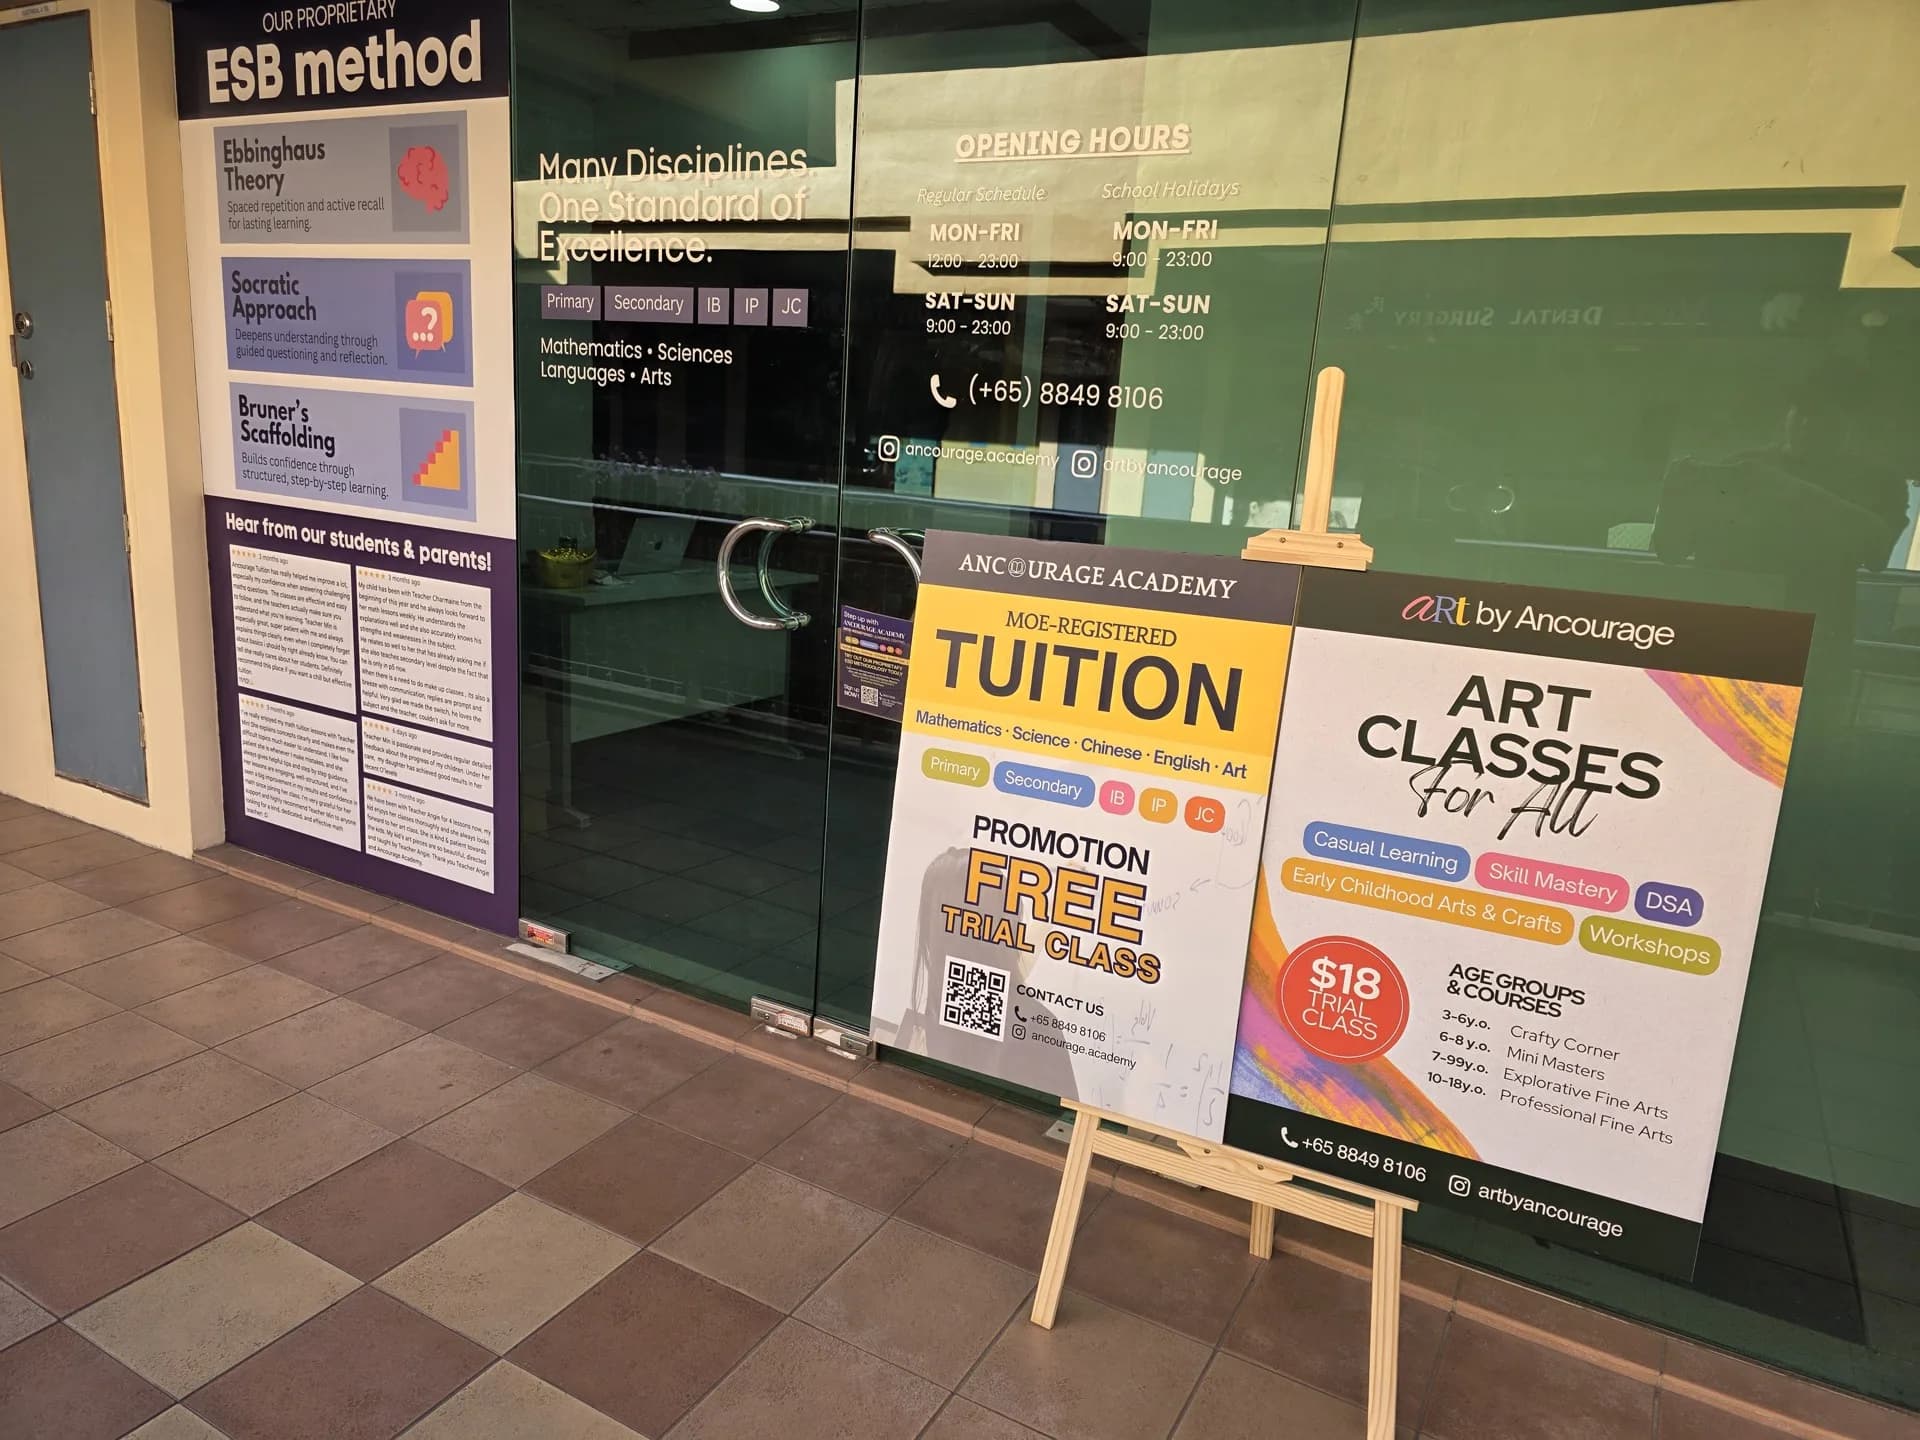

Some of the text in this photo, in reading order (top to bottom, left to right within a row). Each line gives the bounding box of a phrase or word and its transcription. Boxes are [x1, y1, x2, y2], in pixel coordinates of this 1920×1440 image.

[263, 0, 398, 32] OUR PROPRIETARY
[207, 18, 482, 104] ESB method
[223, 136, 326, 169] Ebbinghaus
[955, 123, 1191, 159] OPENING HOURS
[223, 166, 285, 196] Theory
[539, 142, 817, 190] Many Disciplines.
[227, 197, 385, 214] Spaced repetition and active recall
[539, 186, 810, 224] One Standard of
[917, 184, 1048, 206] Regular Schedule
[1102, 180, 1241, 200] School Holidays
[228, 217, 312, 233] for lasting learning.
[930, 223, 1021, 242] MON-FRI
[1113, 220, 1218, 240] MON-FRI
[540, 229, 714, 264] Excellence.
[928, 254, 1018, 269] 12:00 23:00
[1112, 252, 1212, 267] 9:00 23:00
[231, 270, 300, 296] Socratic
[232, 296, 317, 325] Approach
[546, 294, 594, 312] Primary
[614, 294, 684, 316] Secondary
[706, 297, 721, 313] IB
[744, 298, 760, 314] IP
[782, 298, 802, 314] JC
[925, 292, 1016, 311] SAT-SUN
[1106, 294, 1210, 314] SAT-SUN
[234, 328, 378, 349] Deepens understanding through
[926, 320, 1011, 335] 9:00 23:00
[1106, 324, 1204, 340] 9:00 23:00
[236, 345, 388, 366] guided questioning and reflection.
[540, 337, 733, 365] Mathematics Sciences
[540, 360, 672, 387] Languages Arts
[969, 372, 1164, 410] (+65) 8849 8106
[240, 420, 336, 457] Scaffolding
[241, 452, 355, 477] Builds confidence through
[905, 442, 1060, 470] ancourage.academy
[1103, 457, 1242, 482] artbyancourage
[242, 469, 390, 500] structured, step-by-step learning.
[226, 511, 492, 572] Hear from our students & parents!
[1108, 569, 1238, 600] ACADEMY
[1004, 610, 1178, 648] MOE-REGISTERED
[1476, 602, 1511, 633] by
[1515, 604, 1675, 650] Ancourage
[935, 628, 1243, 732] TUITION
[1446, 674, 1592, 732] ART
[916, 709, 1248, 780] Mathematics Science Chinese English Art
[1357, 714, 1664, 800] CLASSES
[930, 756, 982, 782] Primary
[1004, 770, 1082, 800] Secondary
[1110, 789, 1125, 806] IB
[1152, 797, 1167, 812] IP
[1496, 774, 1599, 841] All
[1194, 806, 1215, 824] JC
[972, 814, 1150, 876] PROMOTION
[1314, 830, 1458, 874] Casual Learning
[964, 847, 1148, 946] FREE
[1292, 866, 1562, 934] Early Childhood Arts & Crafts
[1489, 863, 1618, 905] Skill Mastery
[1646, 890, 1694, 918] DSA
[941, 904, 1162, 985] TRIAL CLASS
[1589, 924, 1711, 966] Workshops
[1310, 956, 1382, 1000] $18
[1448, 963, 1586, 1006] AGE GROUPS
[1016, 984, 1104, 1016] CONTACT US
[1308, 988, 1372, 1022] TRIAL
[1446, 980, 1562, 1019] & COURSES
[1030, 1014, 1106, 1042] +65 8849 8106
[1302, 1008, 1379, 1042] CLASS
[1441, 1009, 1620, 1061] 3-6y.o. Crafty Corner
[1031, 1030, 1138, 1070] ancourage.academy
[1506, 1046, 1540, 1068] Mini
[1542, 1055, 1606, 1082] Masters
[1432, 1051, 1670, 1122] 7-99y.o. Explorative Fine Arts
[1426, 1072, 1674, 1145] 10-18y.o. Professional Fine Arts
[1302, 1139, 1426, 1182] +65 8849 8106
[1479, 1184, 1624, 1238] artbyancourage
